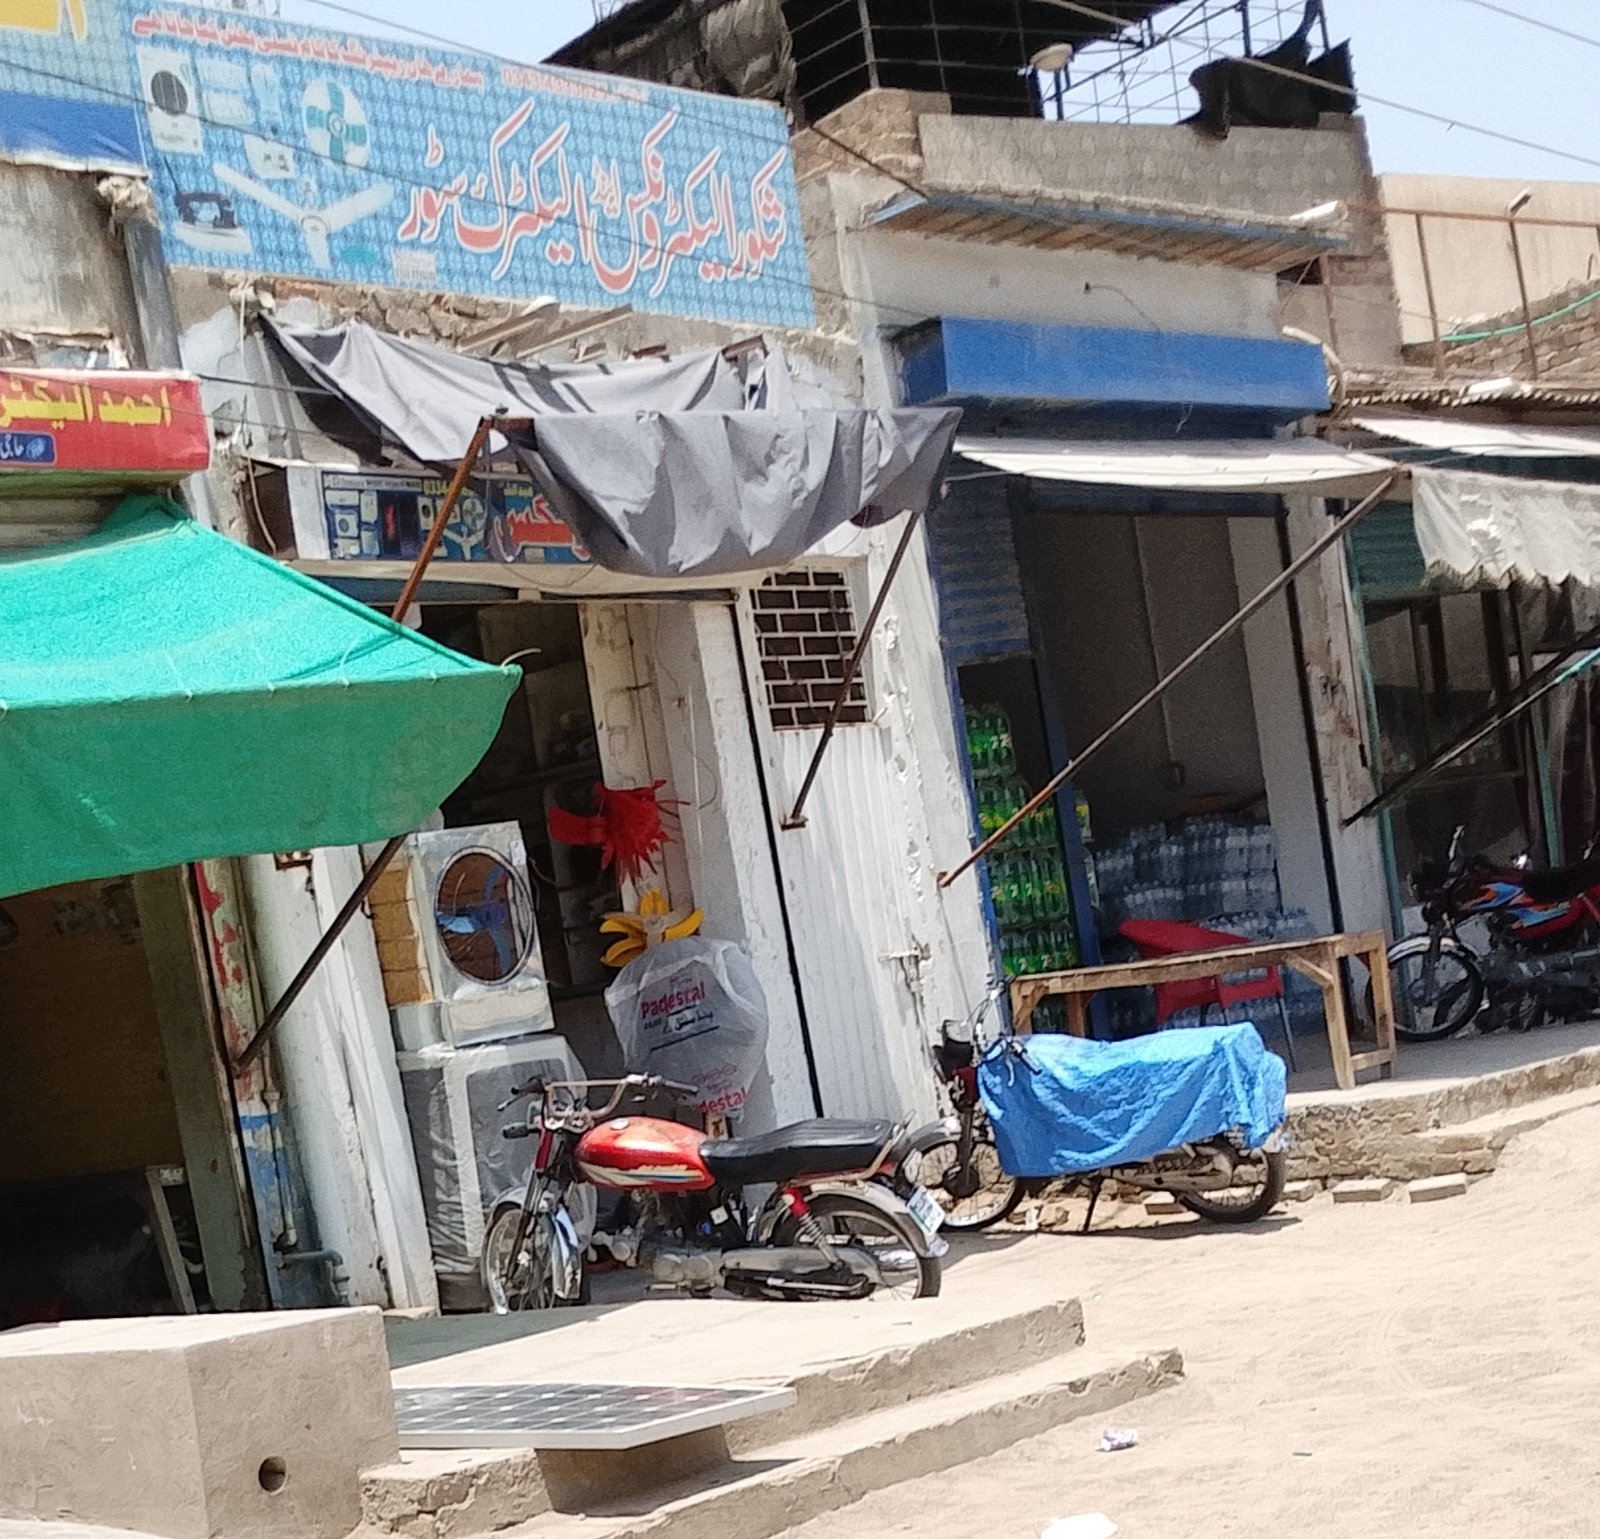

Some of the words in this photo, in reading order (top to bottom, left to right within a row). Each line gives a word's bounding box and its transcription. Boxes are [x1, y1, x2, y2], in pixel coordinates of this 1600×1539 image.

[728, 145, 788, 281] شکور
[0, 377, 94, 430] الیکٹر
[98, 385, 172, 428] احمد
[641, 980, 706, 1020] Padestal
[697, 1086, 747, 1114] destal
